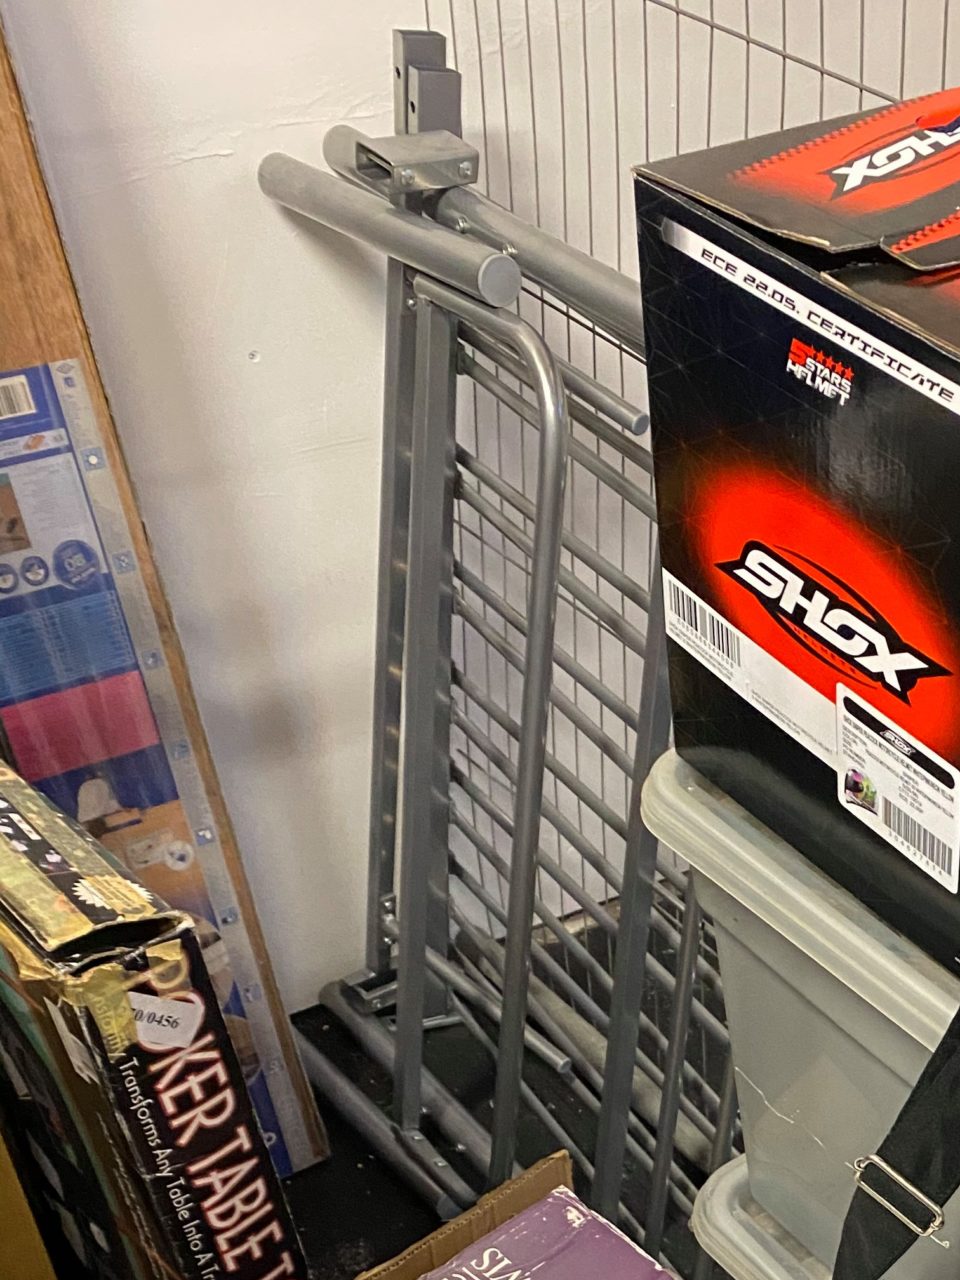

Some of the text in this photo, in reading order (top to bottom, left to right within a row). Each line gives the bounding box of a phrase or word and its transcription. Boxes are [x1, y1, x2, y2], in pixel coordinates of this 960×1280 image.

[700, 248, 737, 277] ECE
[807, 309, 955, 401] CERTIFICATE
[805, 357, 851, 393] STARS
[734, 550, 928, 691] SHOX
[131, 1008, 180, 1029] 0/0456
[118, 1057, 162, 1148] Transforms
[150, 1146, 176, 1178] Any
[164, 1176, 197, 1221] Table
[186, 1126, 284, 1272] TABLE
[181, 1219, 208, 1252] Into
[193, 1250, 215, 1266] A
